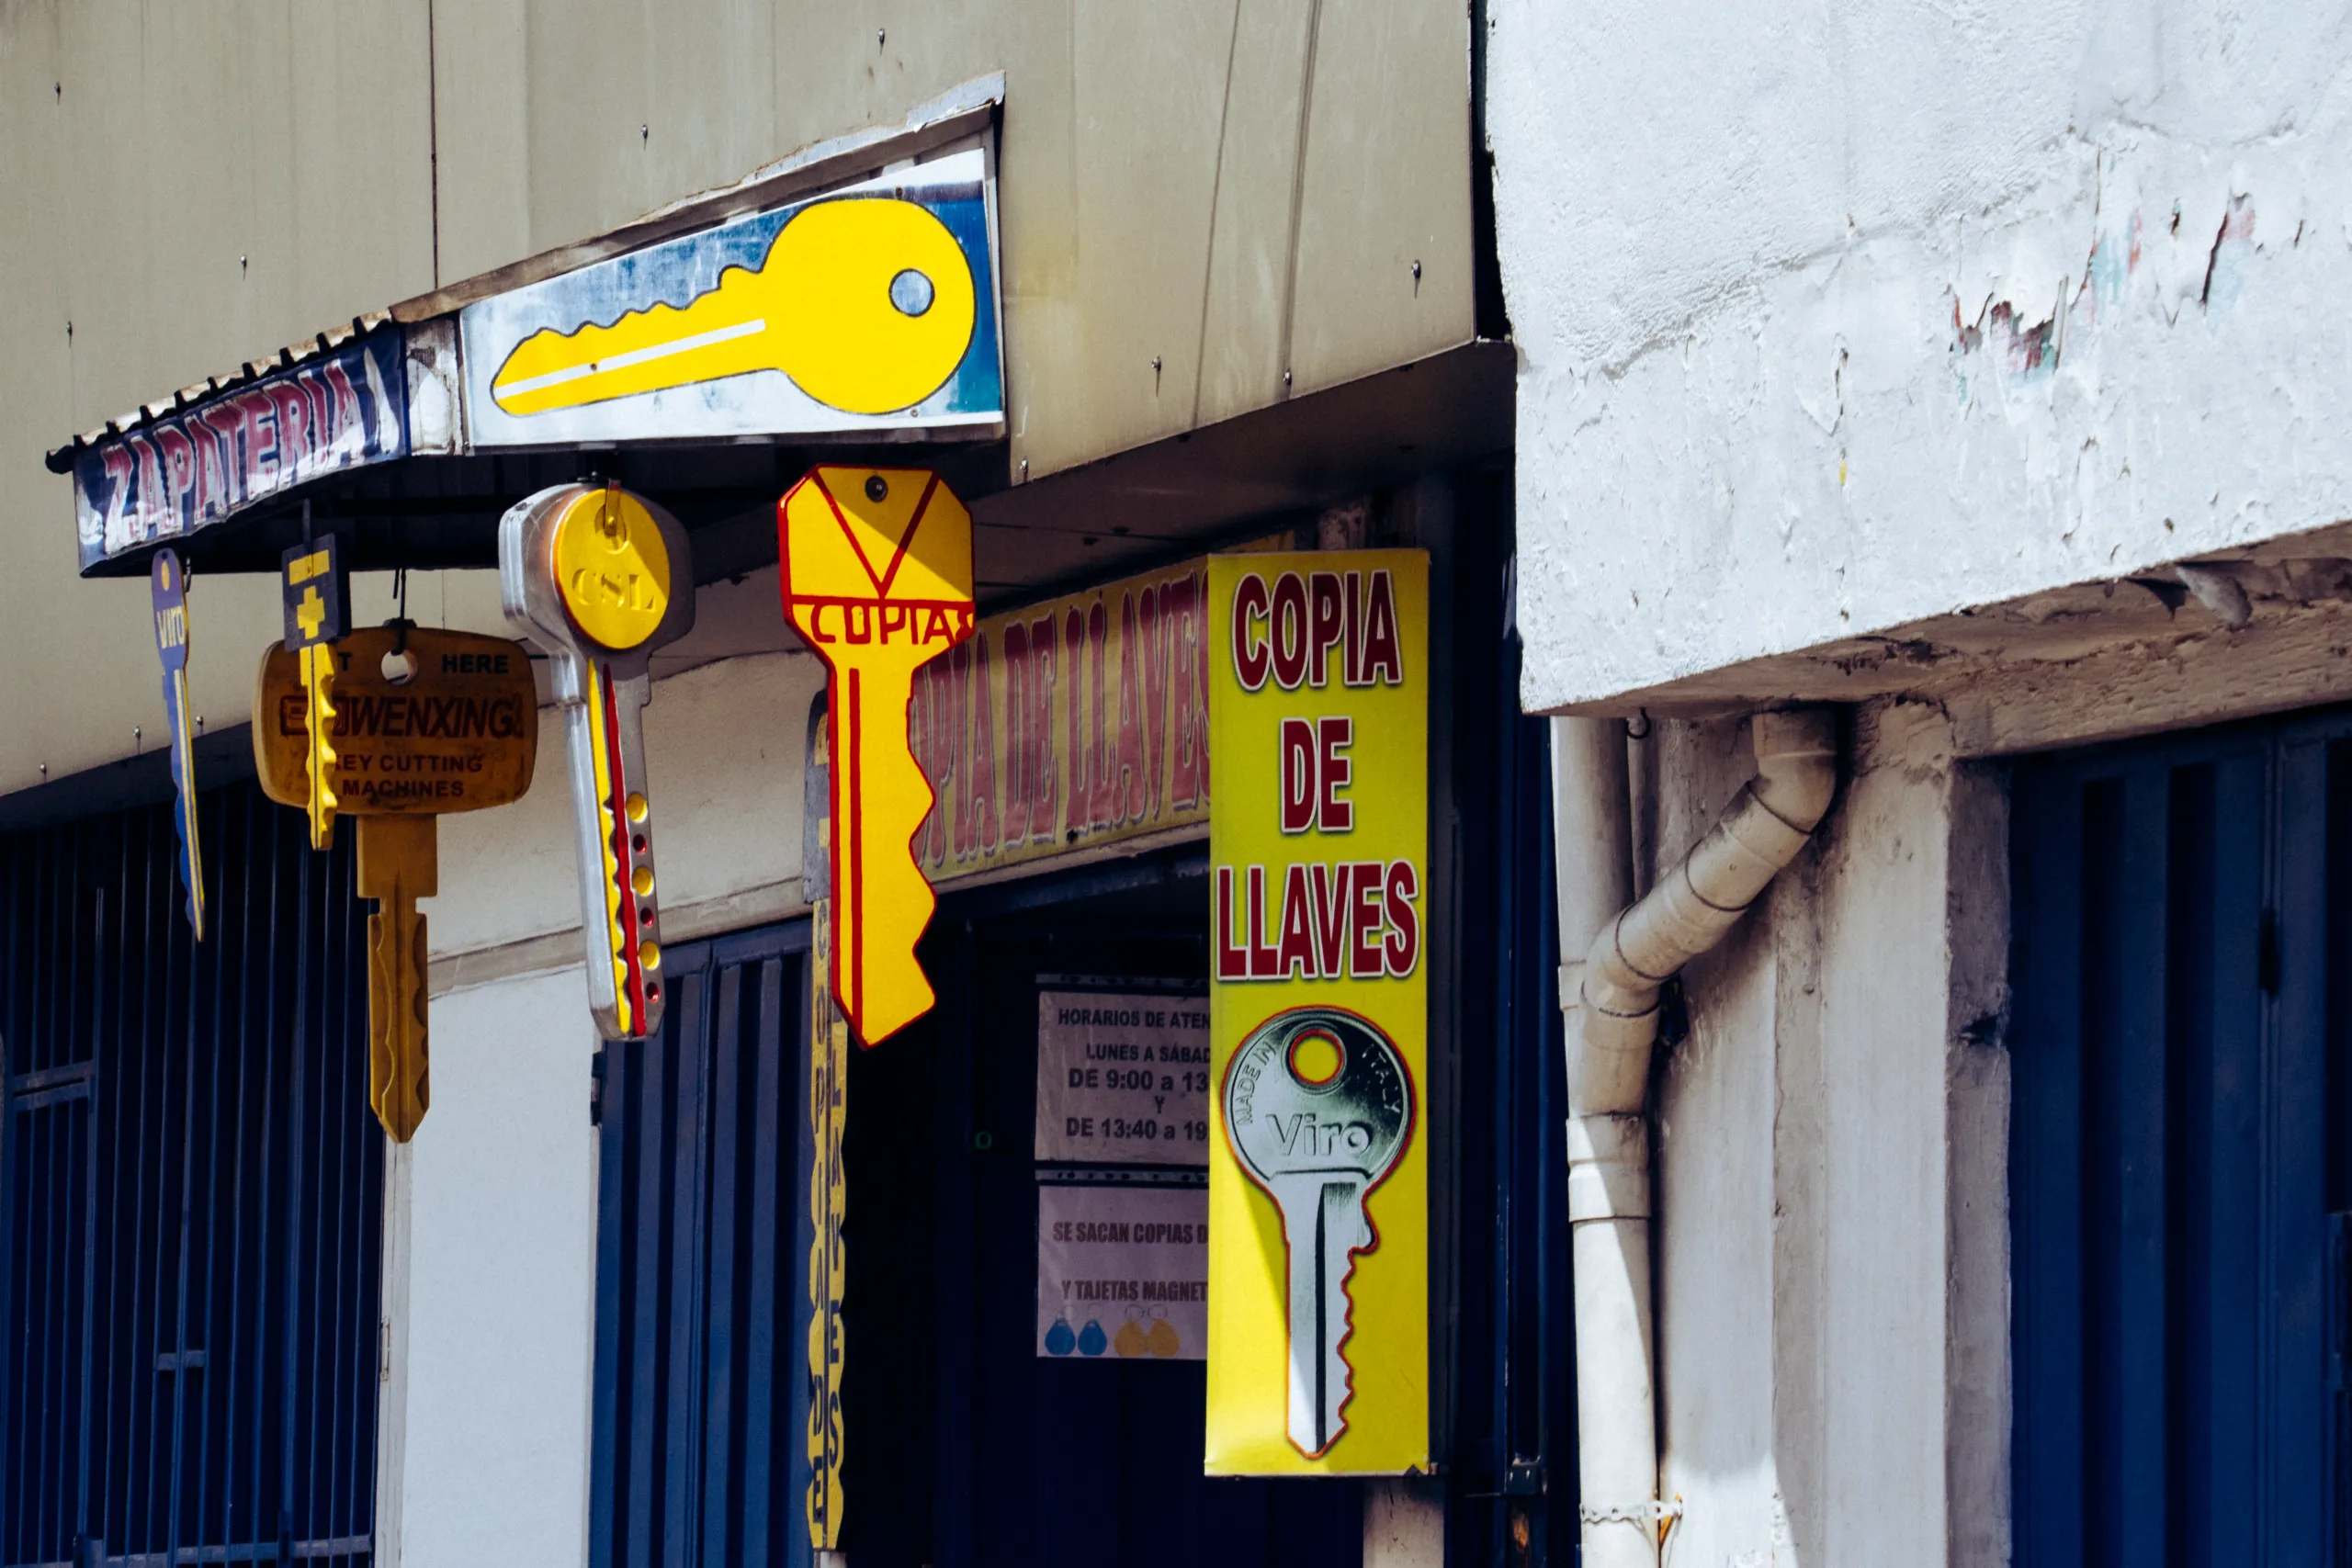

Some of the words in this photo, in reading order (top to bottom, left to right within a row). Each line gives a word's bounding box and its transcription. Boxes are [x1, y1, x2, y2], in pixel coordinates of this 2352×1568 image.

[100, 357, 367, 555] ZAPATERIA
[1232, 570, 1403, 691] COPIA
[442, 653, 509, 674] HERE
[350, 695, 514, 739] WENXING
[1004, 609, 1057, 850] DE
[379, 754, 483, 773] CUTTING
[1281, 716, 1352, 833] DE
[343, 780, 464, 797] MACHINES
[1216, 858, 1420, 981] LLAVES
[1057, 1009, 1140, 1027] HORARIOS
[1146, 1010, 1166, 1028] DE
[1086, 1043, 1139, 1061] LUNES
[1143, 1045, 1154, 1062] A
[1069, 1068, 1099, 1089] DE
[1106, 1069, 1153, 1090] 9:00
[1160, 1075, 1174, 1091] a
[1236, 1064, 1261, 1126] MADE
[1252, 1039, 1277, 1066] IN
[1154, 1095, 1165, 1114] Y
[1067, 1117, 1093, 1137] DE
[1102, 1118, 1157, 1140] 13:40
[1163, 1124, 1176, 1141] a
[1264, 1112, 1374, 1157] Viro
[1053, 1222, 1072, 1242] SE
[1077, 1223, 1129, 1244] SACAN
[1134, 1223, 1193, 1245] COPIAS
[1062, 1280, 1071, 1301] Y
[1075, 1280, 1138, 1302] TAJETAS
